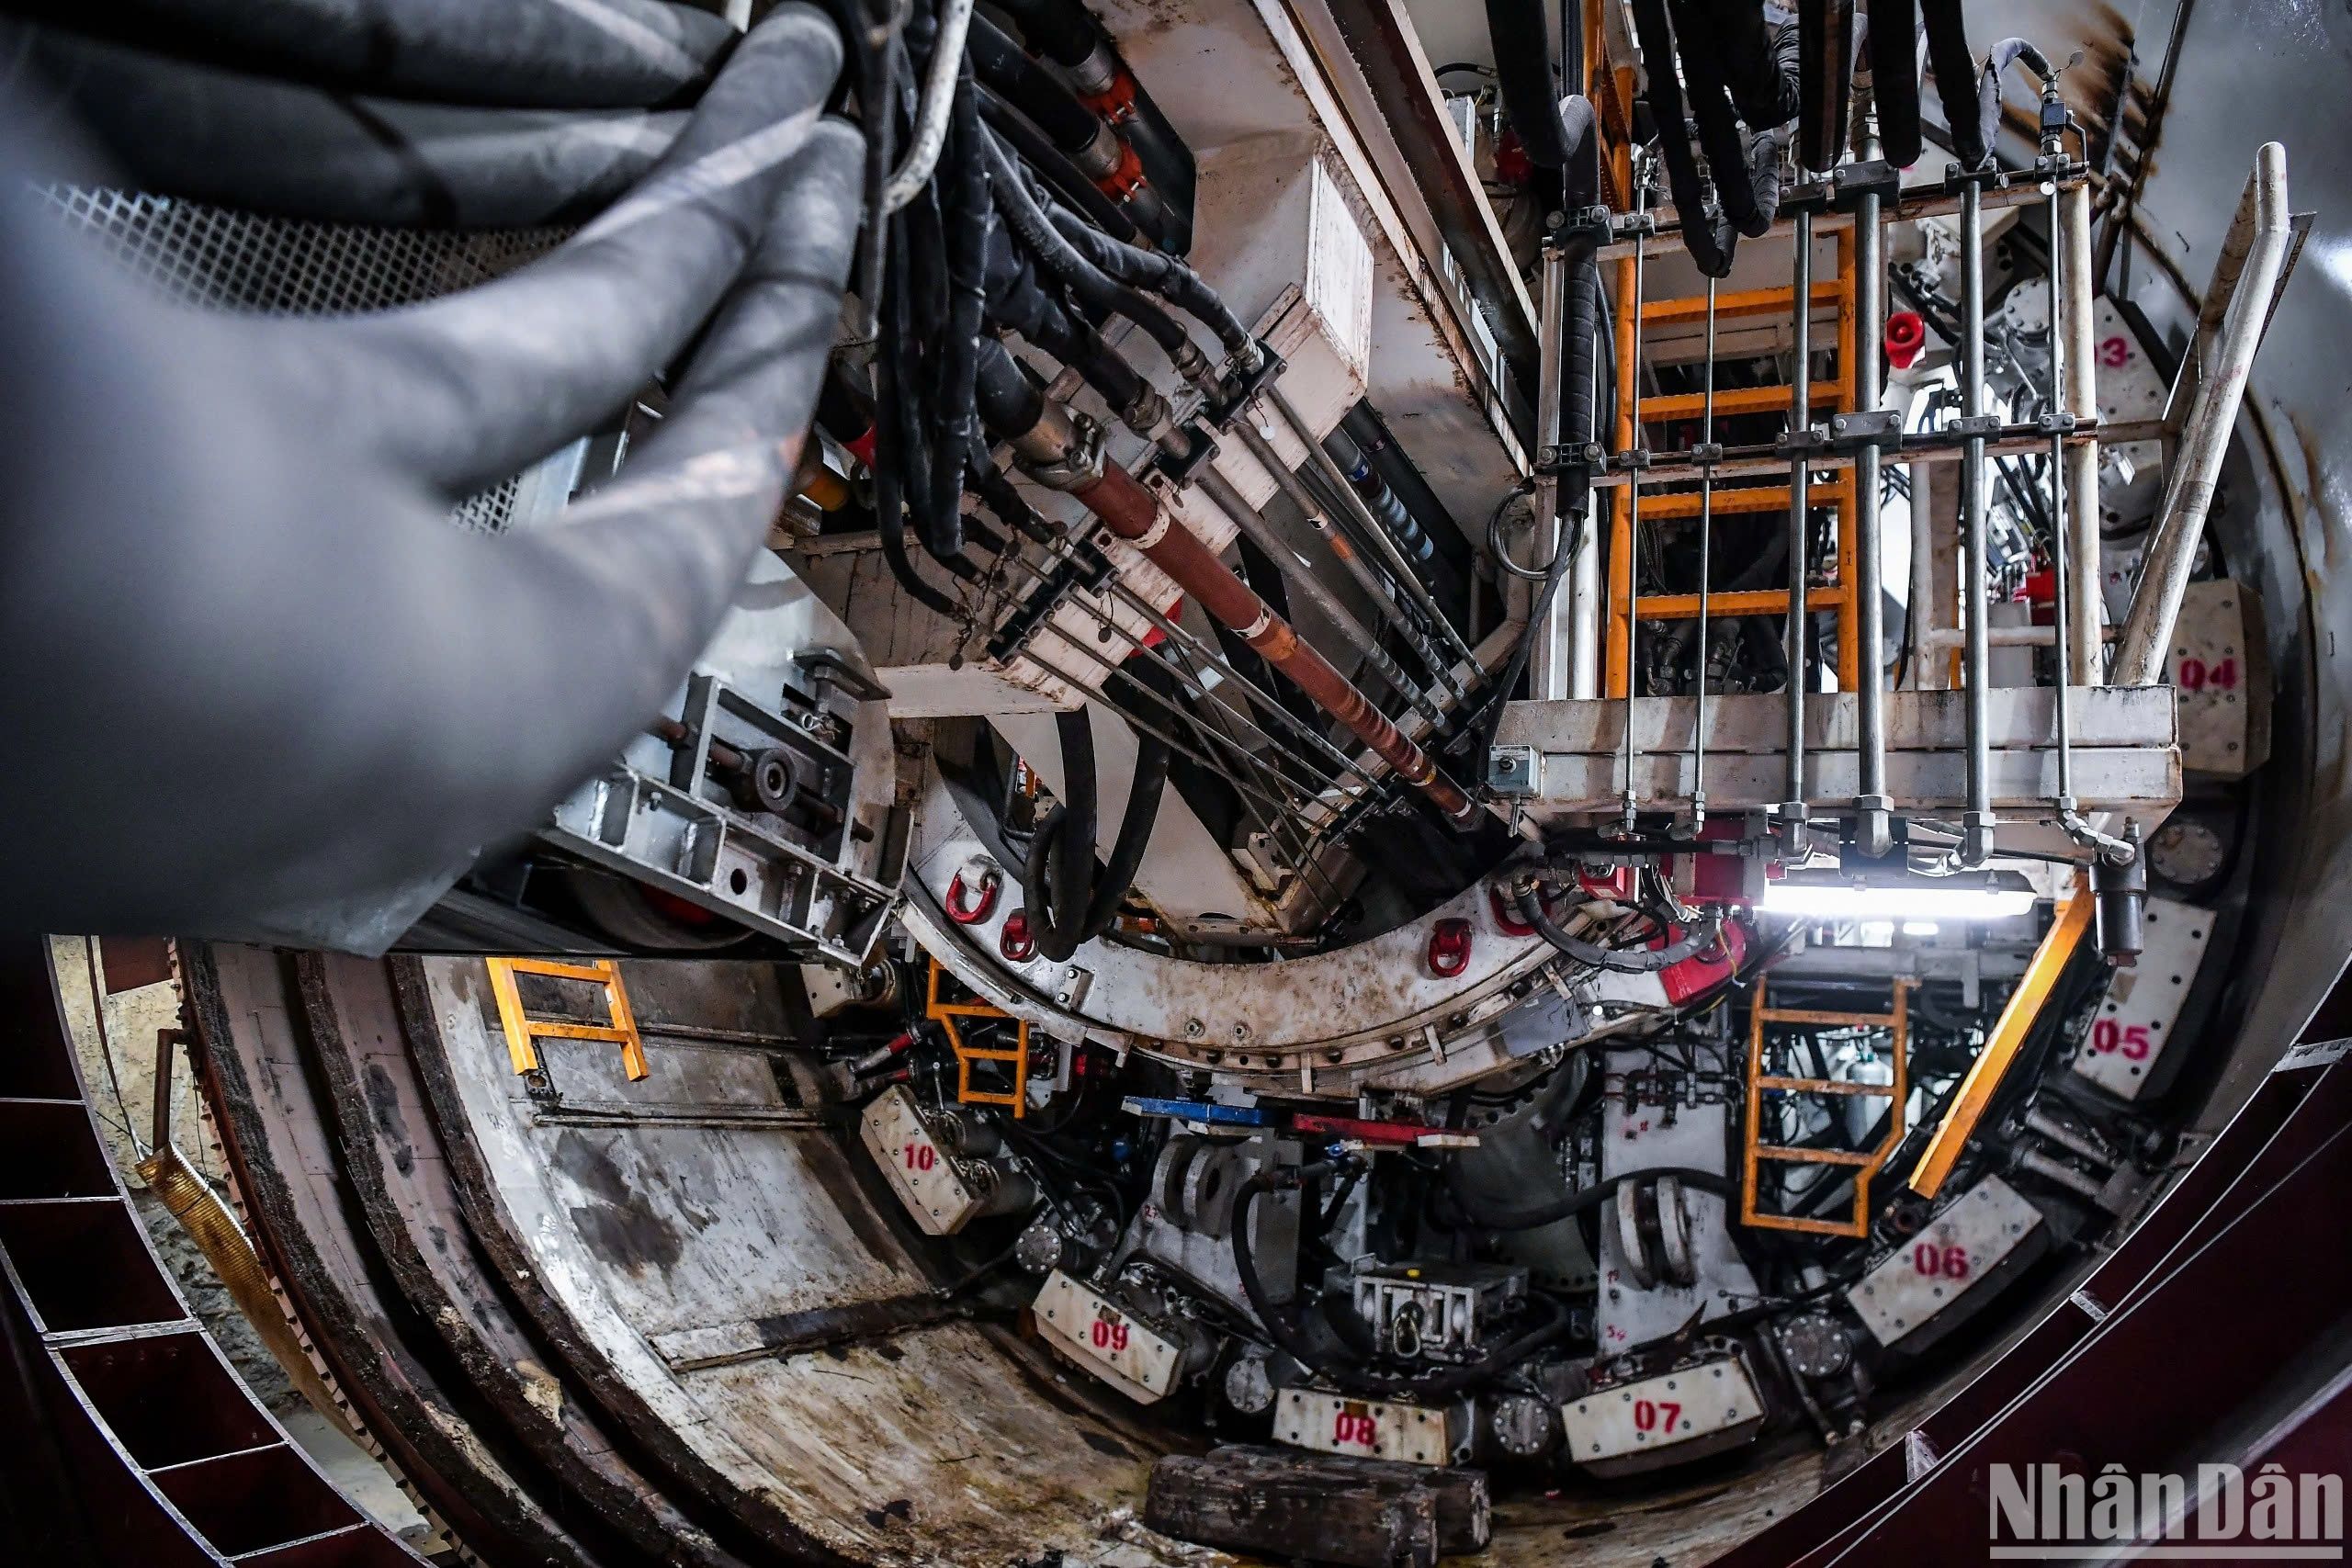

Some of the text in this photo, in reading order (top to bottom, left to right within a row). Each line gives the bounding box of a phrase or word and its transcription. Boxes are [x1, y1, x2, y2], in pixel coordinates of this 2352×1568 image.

[2094, 336, 2128, 367] 3
[2179, 659, 2236, 690] 04
[2093, 1020, 2150, 1060] 05
[904, 1144, 935, 1171] 10
[1914, 1244, 1968, 1280] 06
[1092, 1321, 1128, 1351] 09
[1335, 1412, 1376, 1446] 08
[1634, 1399, 1681, 1434] 07
